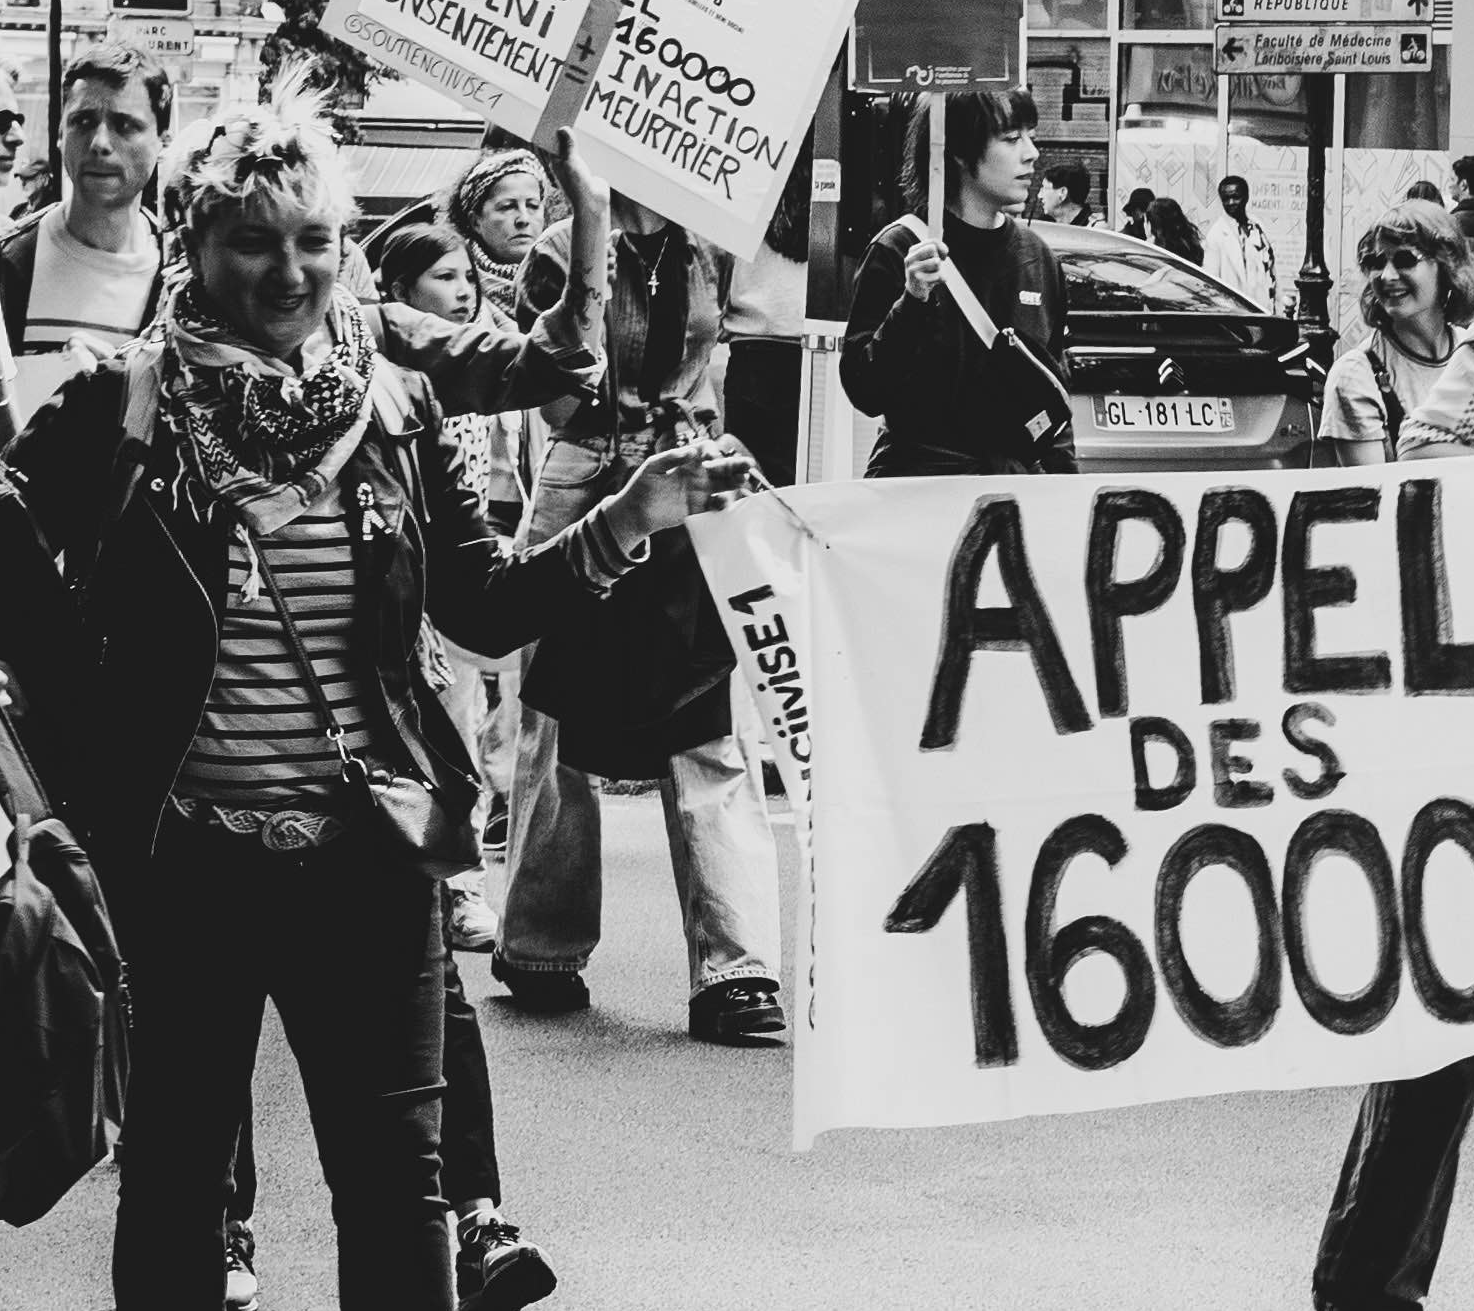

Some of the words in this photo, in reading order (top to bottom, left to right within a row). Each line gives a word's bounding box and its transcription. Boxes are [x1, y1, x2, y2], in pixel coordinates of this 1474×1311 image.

[615, 16, 756, 107] 160000
[1254, 33, 1304, 48] Faculté
[1309, 33, 1325, 47] de
[1330, 32, 1392, 48] Médecine
[1327, 52, 1358, 66] Saint
[1361, 51, 1392, 66] Louis
[608, 49, 788, 171] INACTION
[1128, 701, 1345, 811] DES
